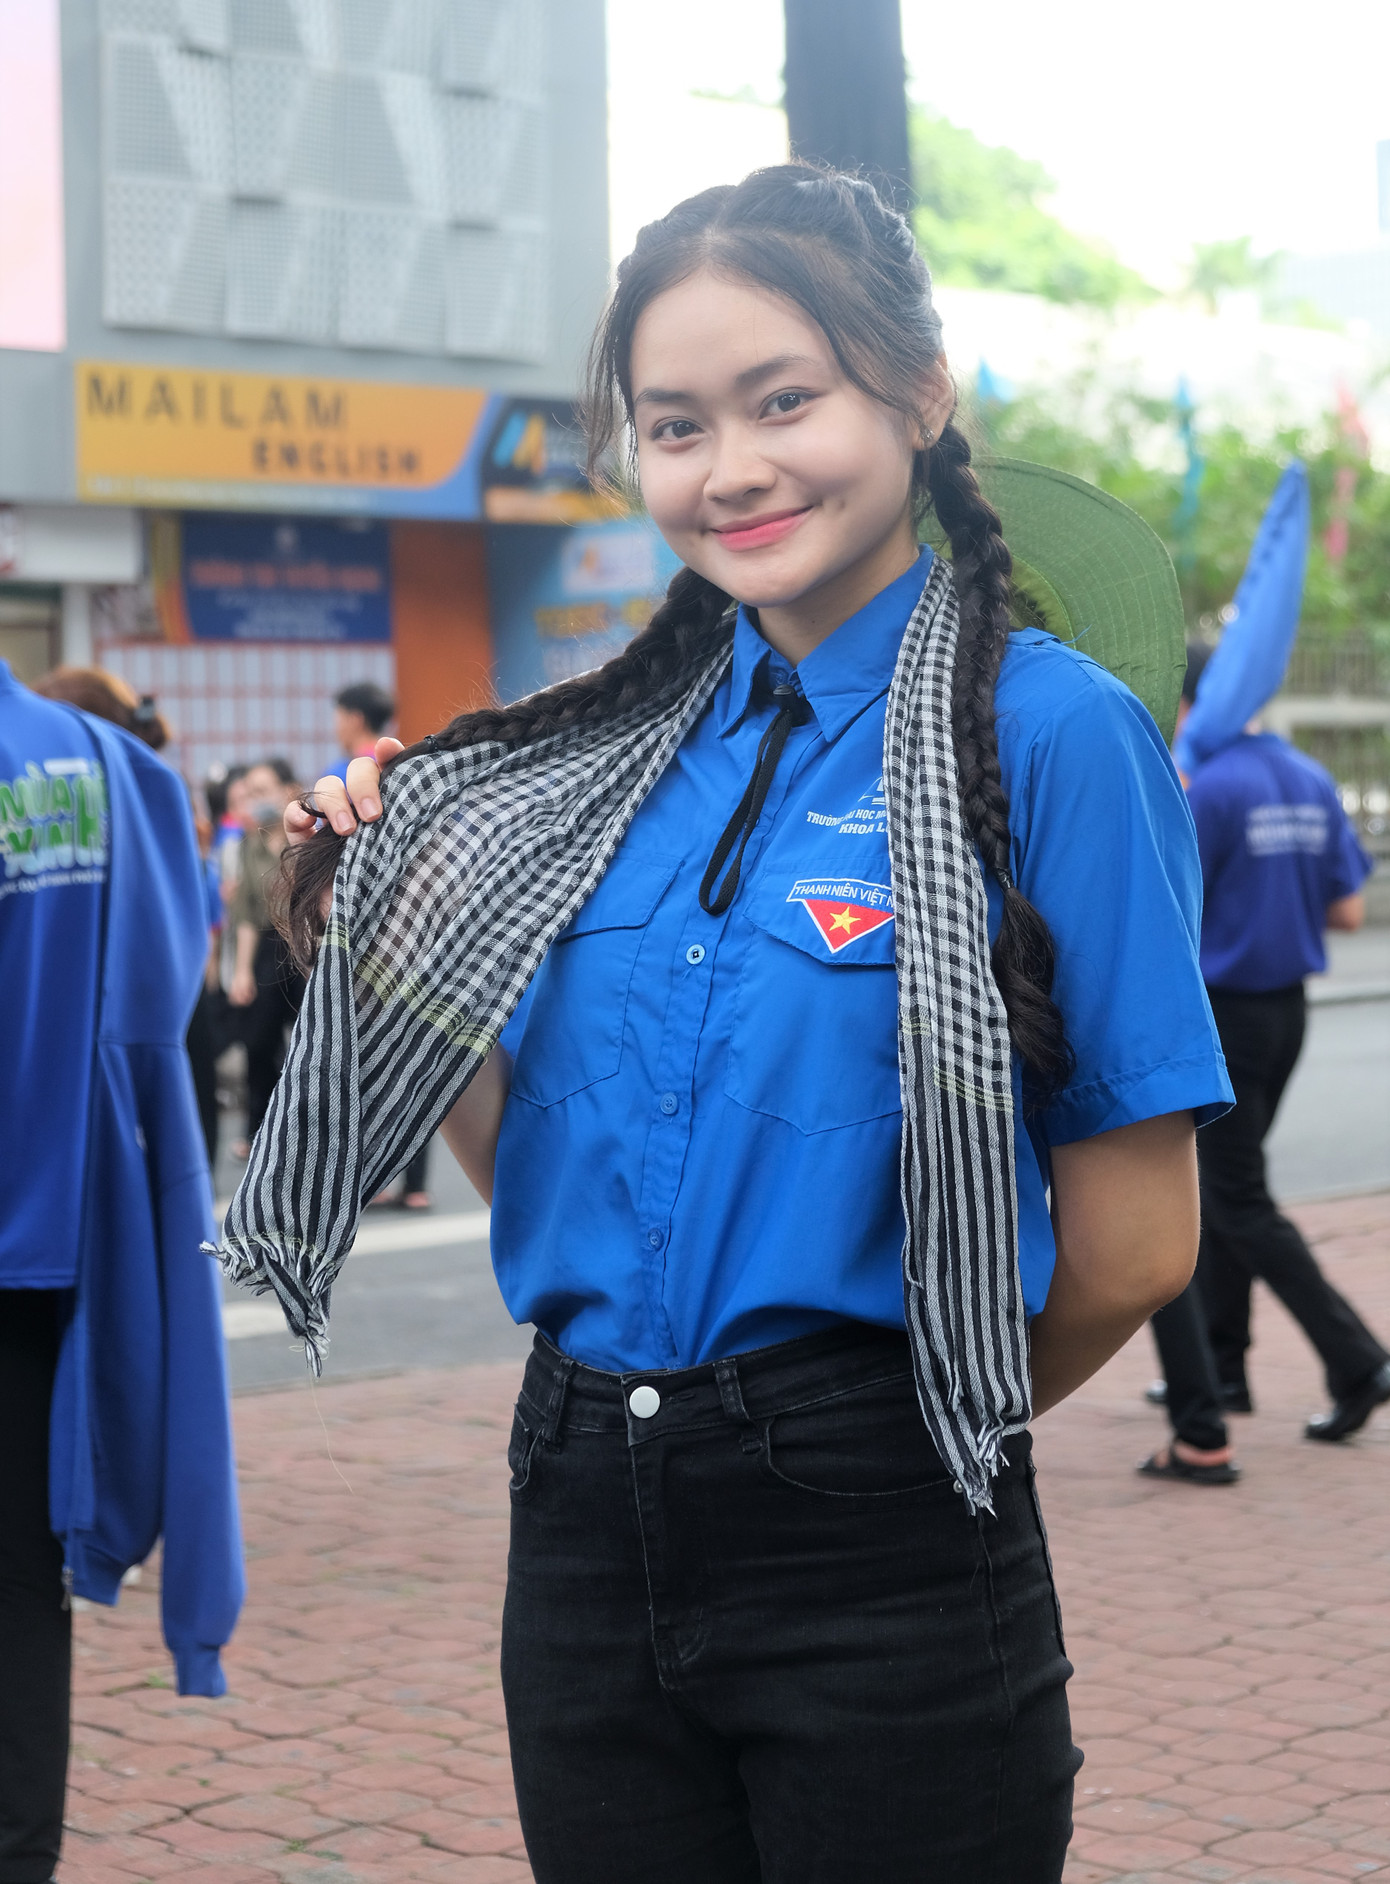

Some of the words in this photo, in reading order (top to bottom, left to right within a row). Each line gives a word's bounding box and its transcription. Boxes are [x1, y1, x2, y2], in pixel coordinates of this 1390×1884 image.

[85, 370, 349, 430] MAILAM
[252, 436, 420, 477] ENGLISH
[855, 809, 875, 821] HỌC
[838, 822, 875, 834] KHOA
[794, 884, 832, 896] THANH
[831, 882, 858, 898] NIÊN
[860, 888, 887, 906] VIỆT
